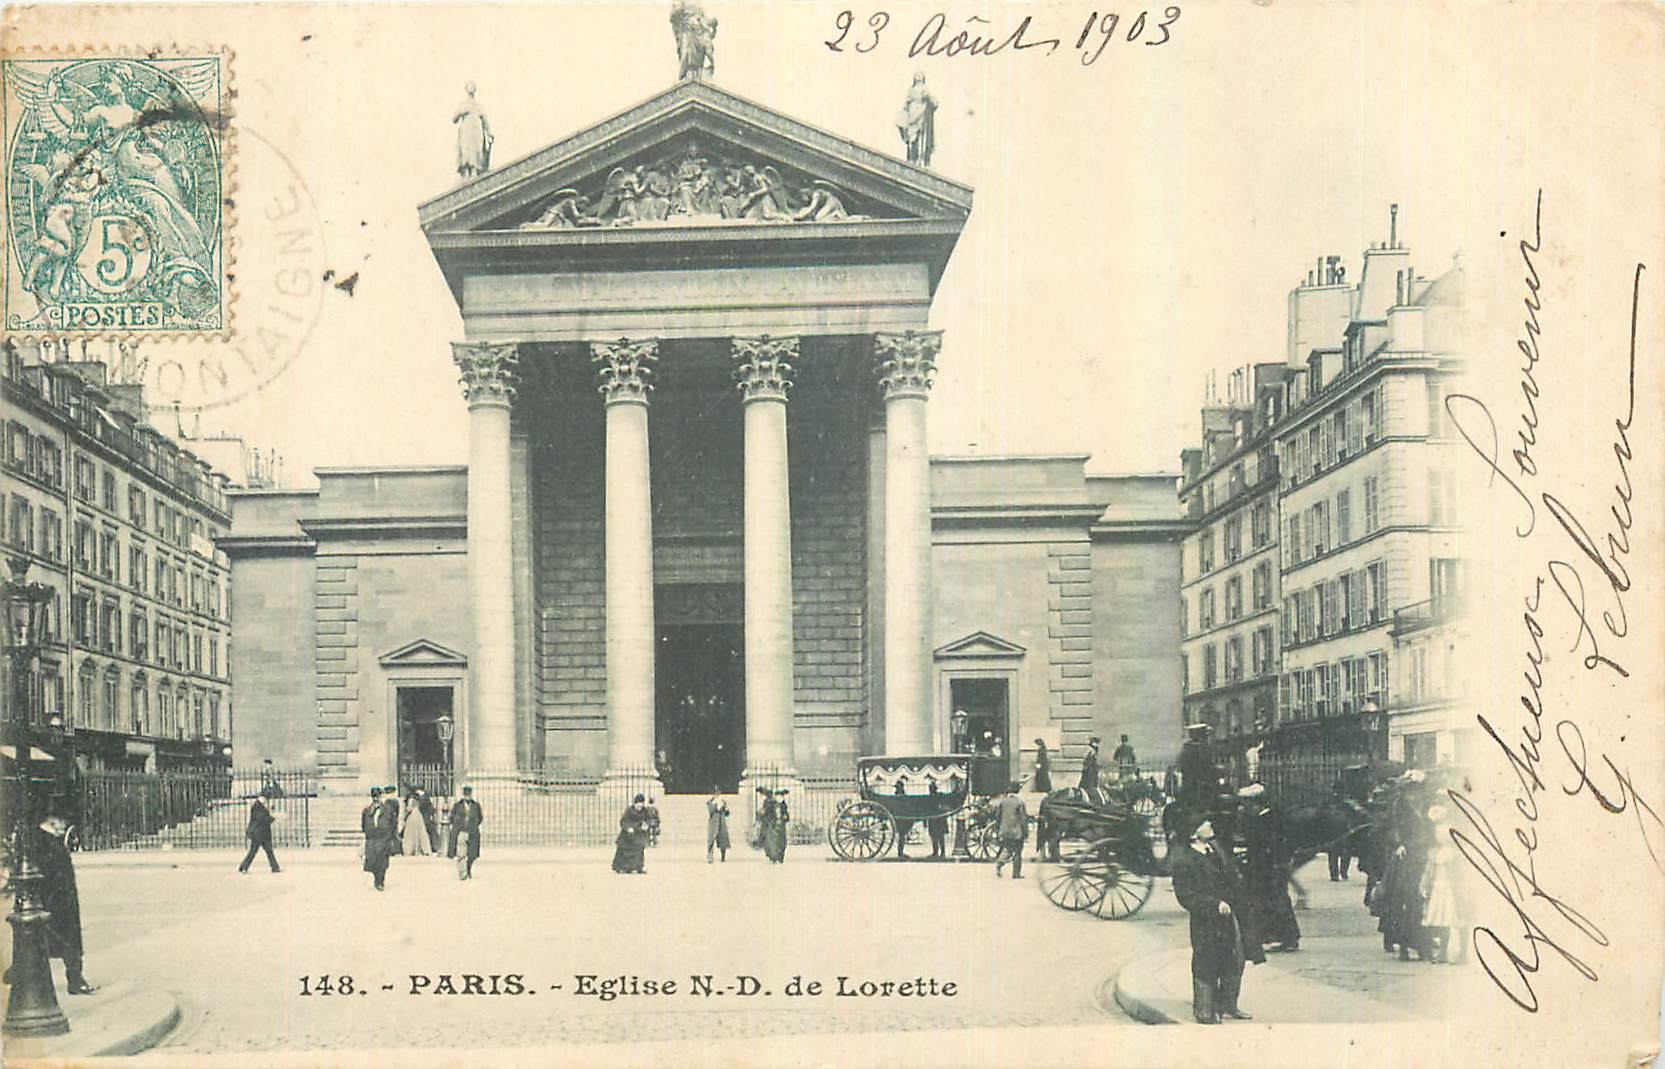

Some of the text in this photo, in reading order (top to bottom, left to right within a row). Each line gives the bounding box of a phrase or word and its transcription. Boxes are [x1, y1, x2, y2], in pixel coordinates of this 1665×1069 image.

[824, 10, 891, 53] 23
[1075, 6, 1182, 66] 1903
[67, 305, 161, 327] POSTES
[1445, 188, 1542, 540] Souvenir
